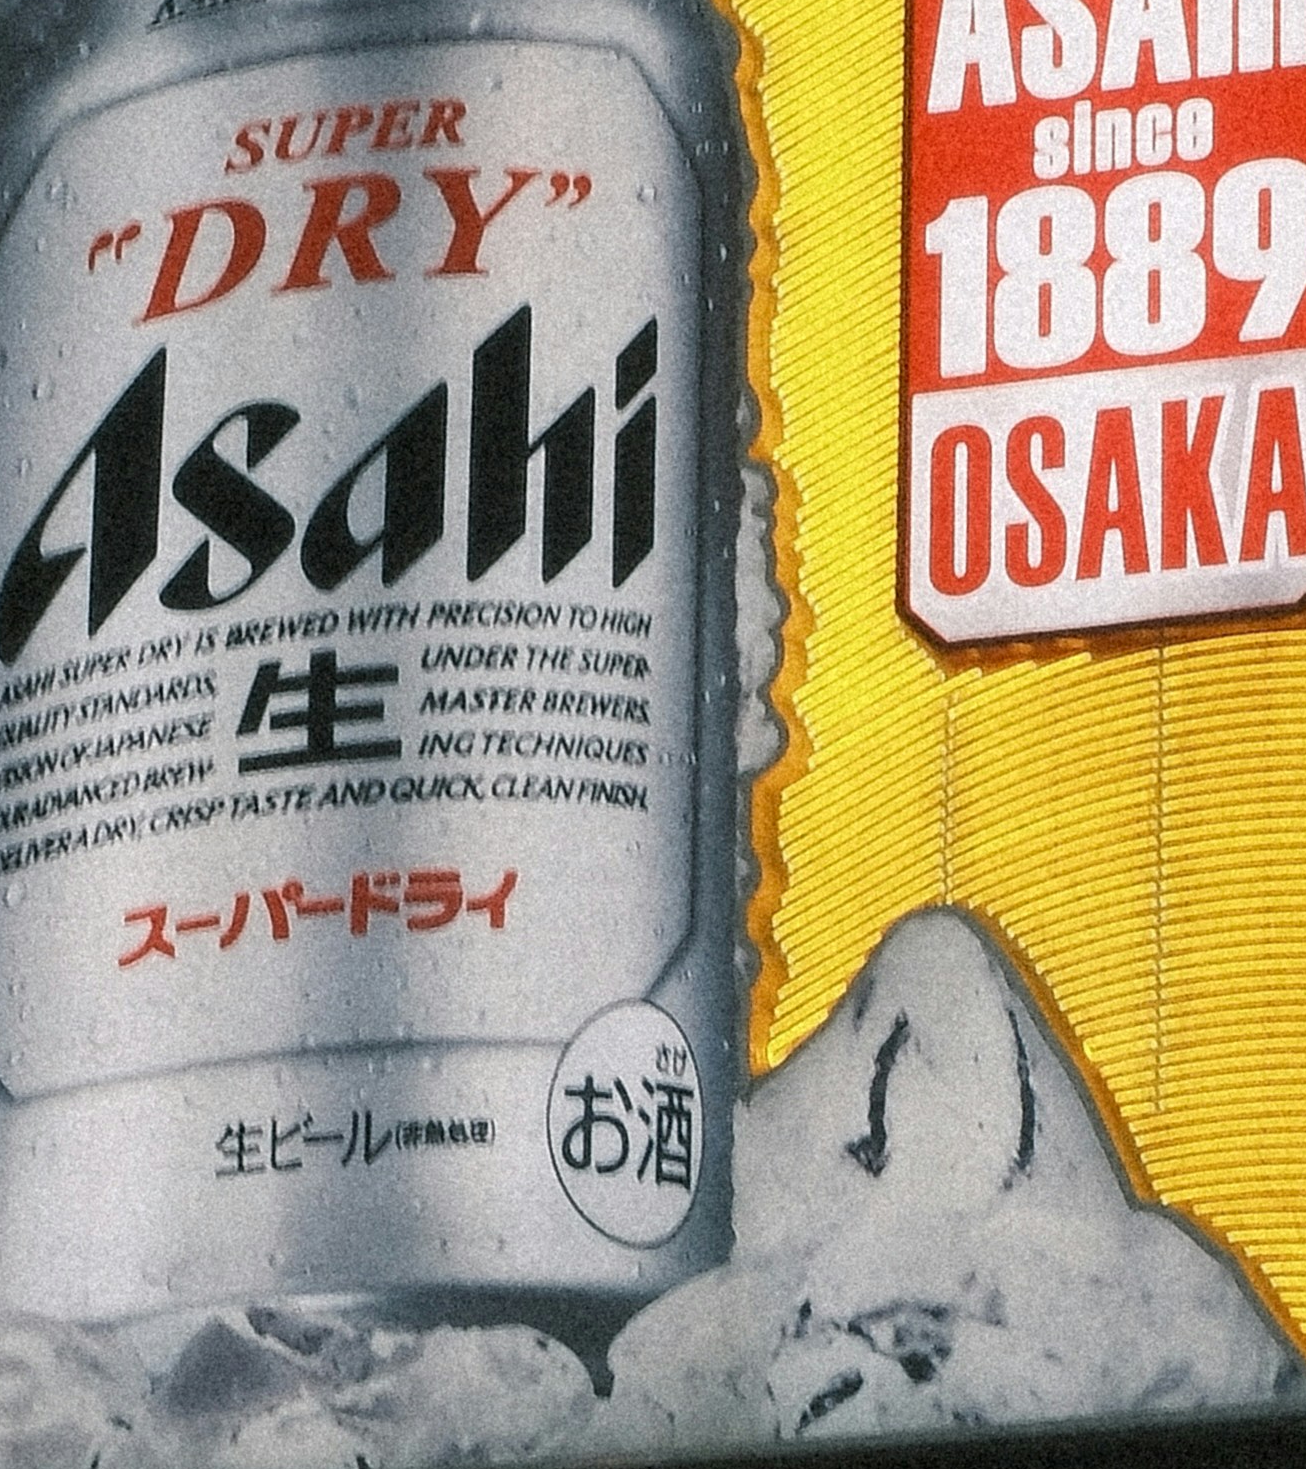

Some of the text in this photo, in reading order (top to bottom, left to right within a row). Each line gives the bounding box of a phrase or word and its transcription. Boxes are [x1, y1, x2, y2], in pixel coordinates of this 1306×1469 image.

[224, 96, 467, 175] SUPER
[1033, 96, 1215, 181] since
[58, 646, 132, 689] SUPER
[225, 609, 339, 649] BREWED
[347, 602, 421, 634] WITH
[427, 600, 562, 630] PRECISION
[568, 604, 599, 631] TO
[599, 608, 653, 639] HIGH
[419, 643, 652, 680] UNDER THE SUPER
[235, 645, 402, 773] 生
[418, 686, 537, 716] MASTER
[417, 730, 650, 767] ING TECHNIQUES
[321, 777, 387, 810] AND
[491, 775, 576, 803] CLEAN
[116, 866, 519, 969] スーパードライ
[560, 1074, 695, 1192] お酒
